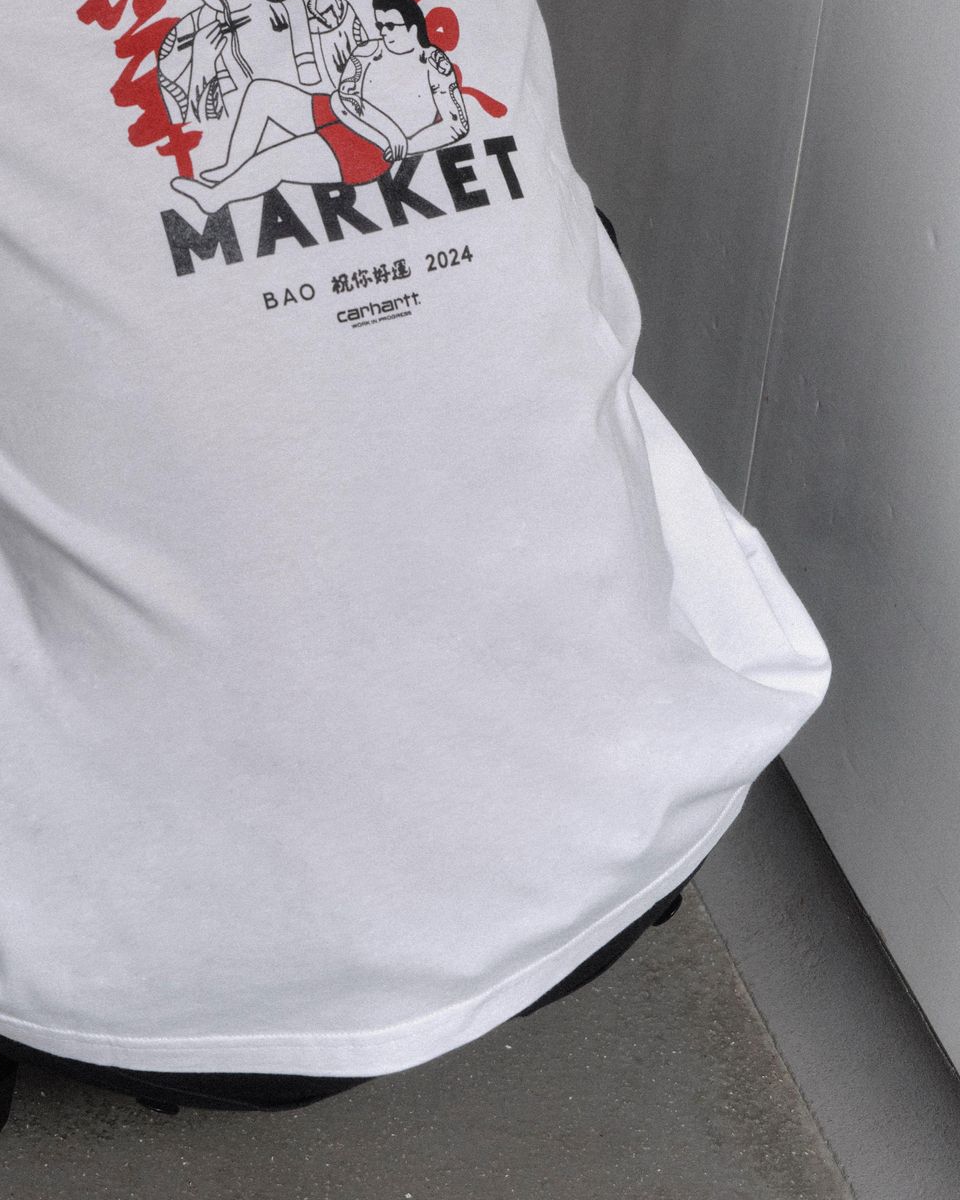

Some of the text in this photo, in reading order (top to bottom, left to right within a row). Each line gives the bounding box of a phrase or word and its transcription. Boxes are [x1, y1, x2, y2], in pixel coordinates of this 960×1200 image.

[160, 135, 525, 277] MARKET
[262, 245, 474, 310] BAO 祝你好運 2024
[352, 317, 371, 329] WORK
[378, 310, 413, 322] PROGRESS
